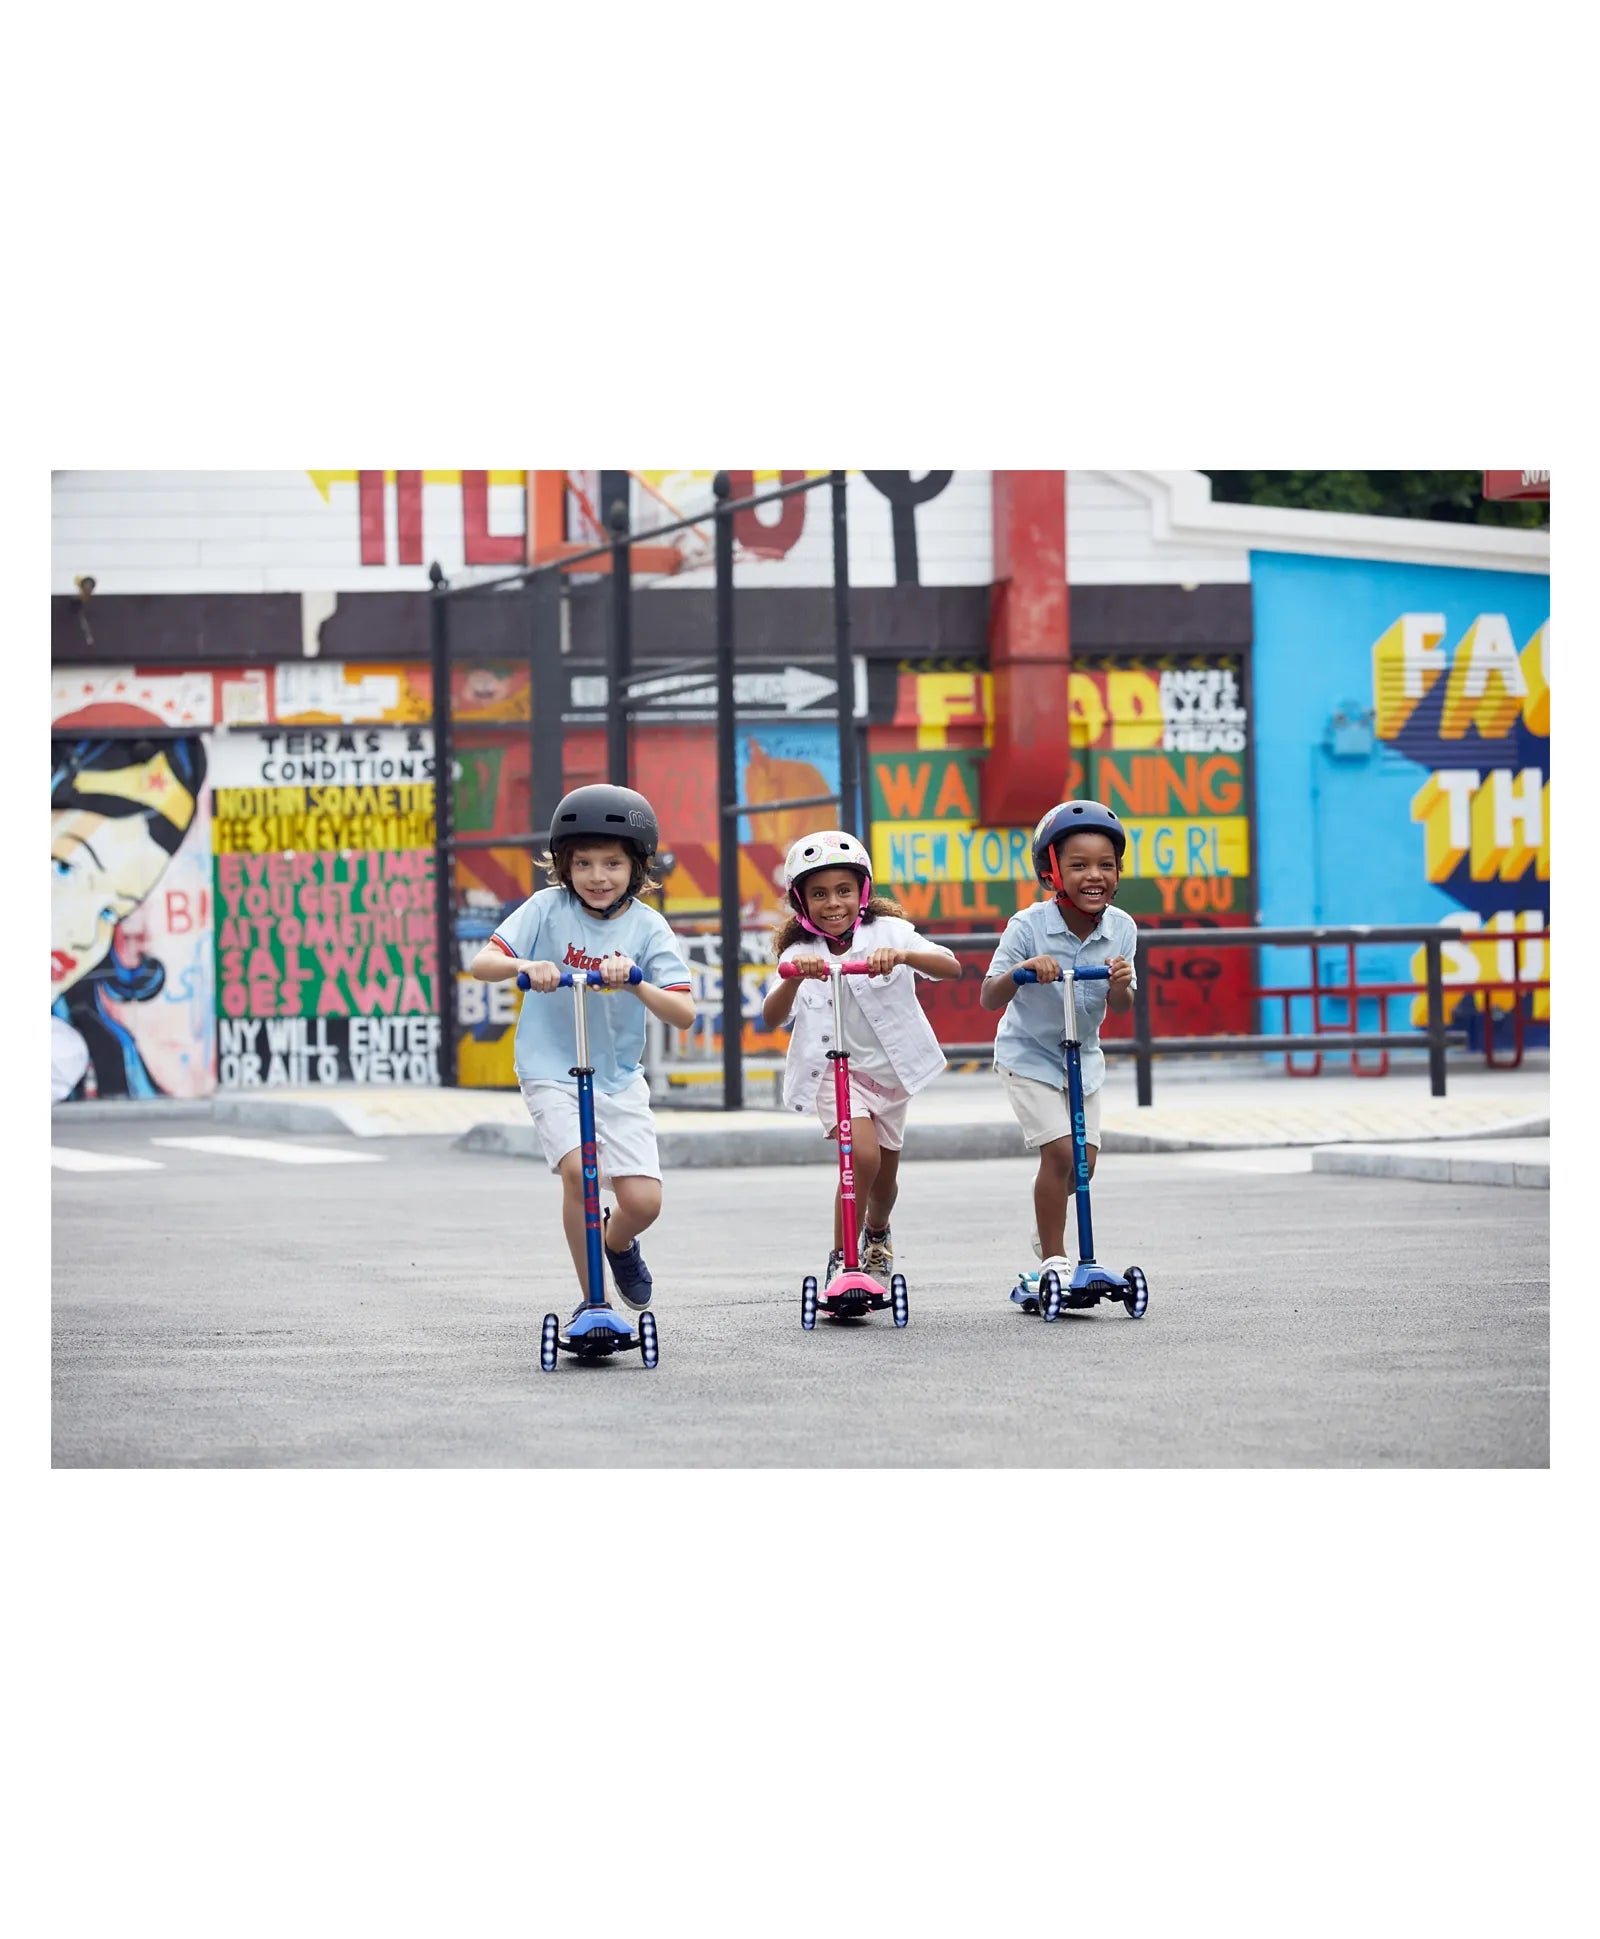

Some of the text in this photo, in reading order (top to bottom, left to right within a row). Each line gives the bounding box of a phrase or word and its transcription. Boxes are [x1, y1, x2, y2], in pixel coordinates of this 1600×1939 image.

[262, 735, 380, 753] TERMS
[262, 760, 436, 781] CONDITIONS
[890, 833, 949, 883] NEW
[892, 881, 1000, 918] WILL
[1154, 877, 1233, 914] YOU
[839, 1119, 854, 1186] micro
